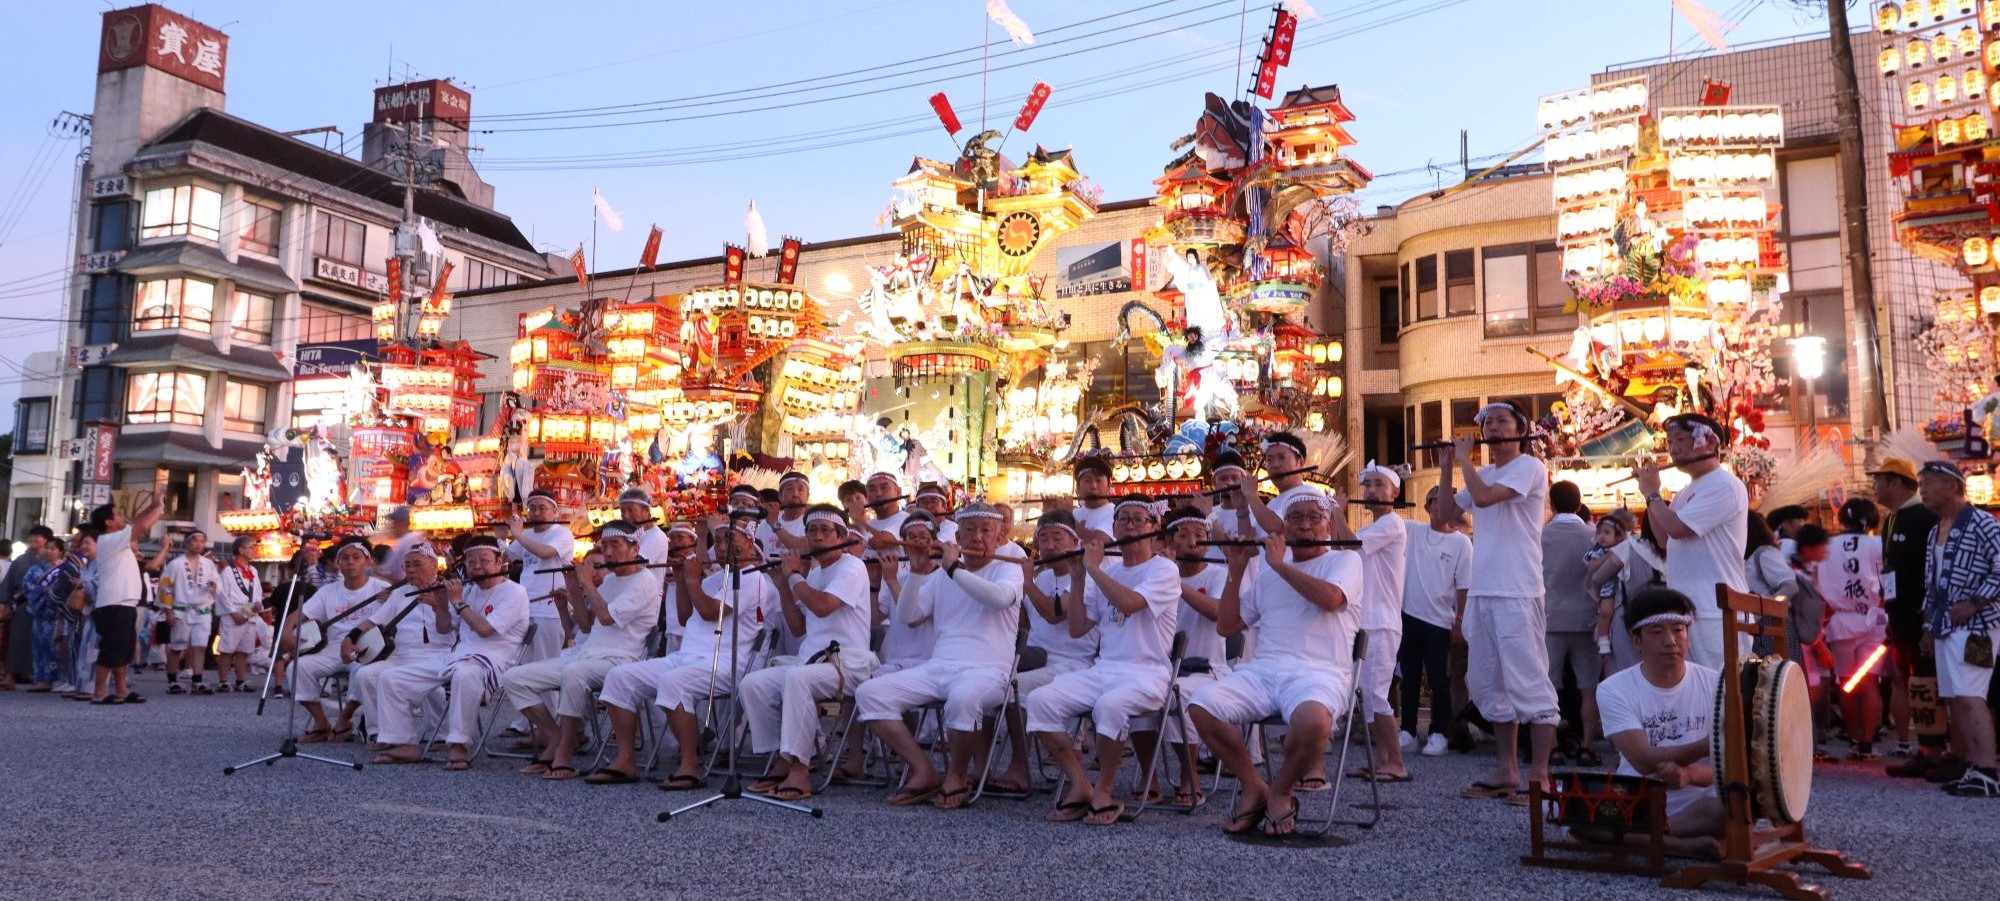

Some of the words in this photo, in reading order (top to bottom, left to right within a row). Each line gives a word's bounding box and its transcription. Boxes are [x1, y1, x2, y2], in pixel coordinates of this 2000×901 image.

[1275, 17, 1293, 61] 大和町
[1261, 66, 1274, 94] 和町
[300, 349, 322, 361] HITA
[300, 364, 317, 376] Bus
[319, 361, 357, 375] Termina
